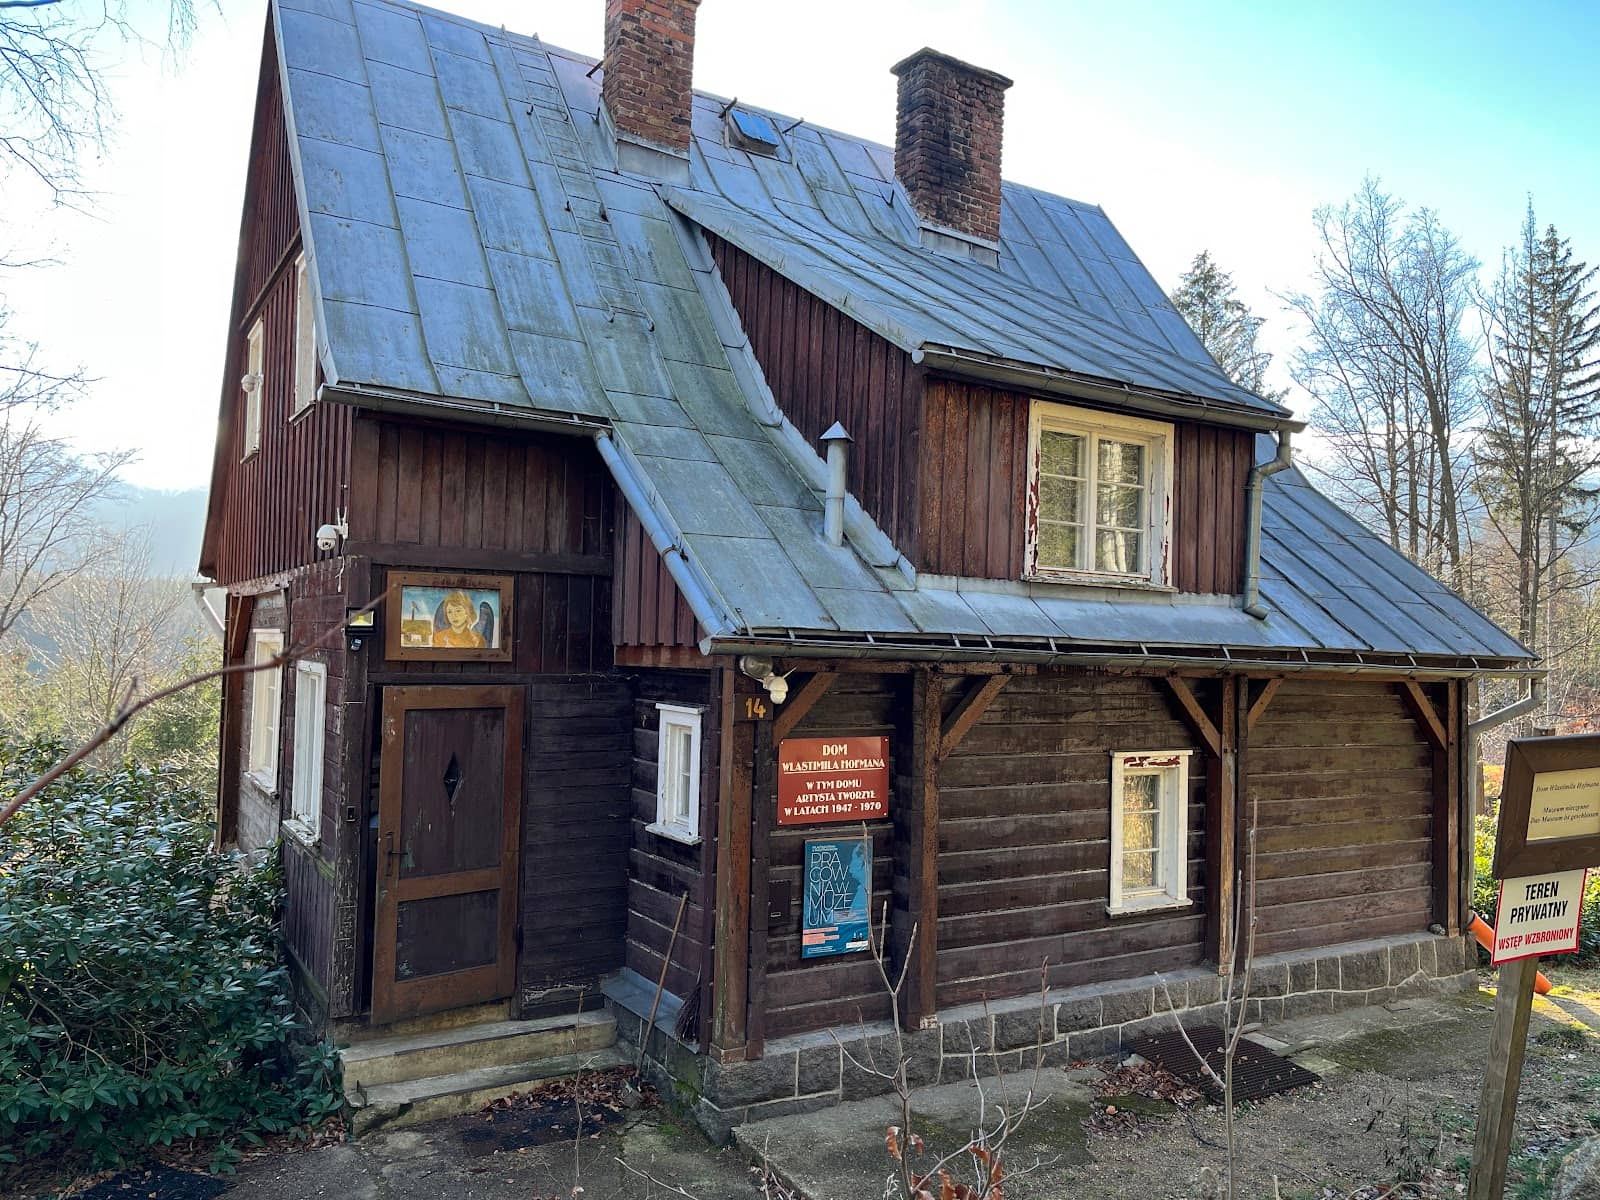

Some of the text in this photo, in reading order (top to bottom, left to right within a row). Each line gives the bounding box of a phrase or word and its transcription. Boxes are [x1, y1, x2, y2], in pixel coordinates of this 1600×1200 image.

[746, 697, 767, 719] 14
[822, 743, 848, 756] DOM
[840, 758, 886, 770] HOFMANA
[806, 778, 862, 791] W TYM DOMU
[795, 790, 877, 803] ARTYSTA TWORZYŁ
[784, 807, 793, 816] W
[793, 804, 829, 816] LATACH
[831, 803, 853, 813] 1947
[860, 801, 882, 811] 1970
[1525, 881, 1559, 901] TEREN
[1510, 900, 1569, 924] PRYWATNY
[1498, 927, 1574, 951] WSTĘP WZBRONIONY
